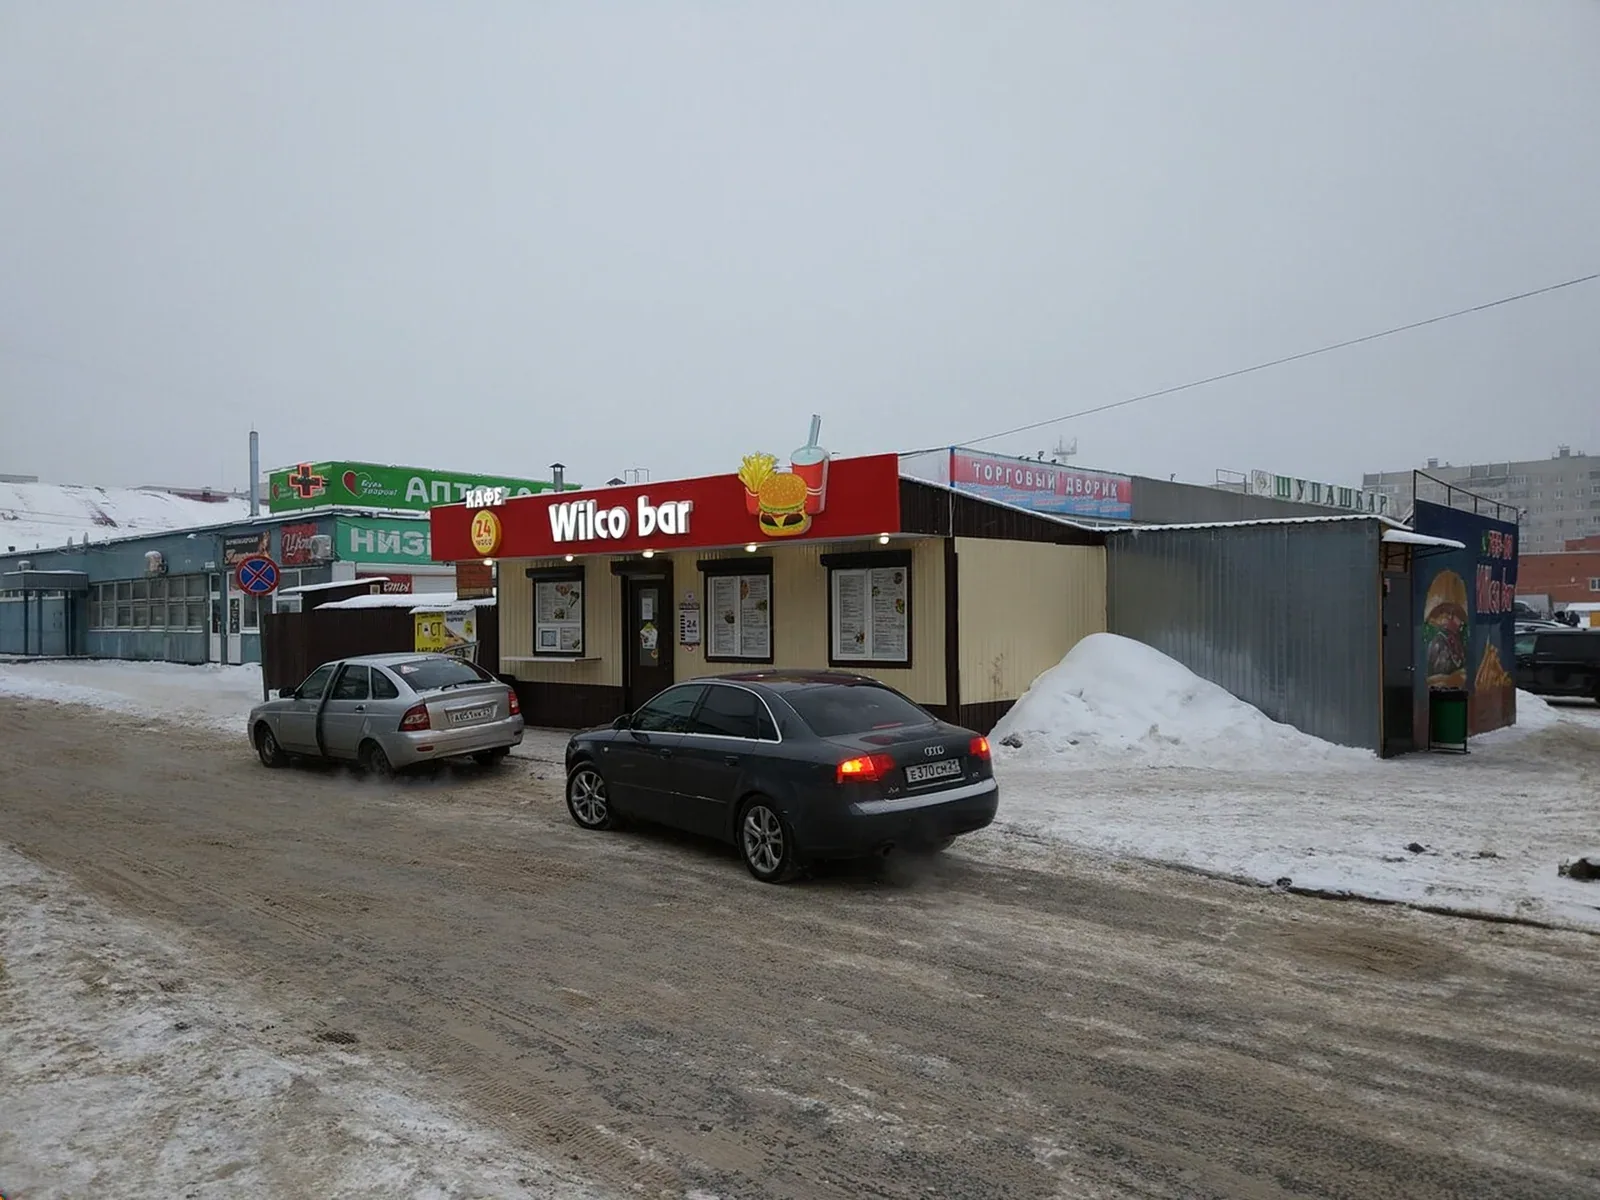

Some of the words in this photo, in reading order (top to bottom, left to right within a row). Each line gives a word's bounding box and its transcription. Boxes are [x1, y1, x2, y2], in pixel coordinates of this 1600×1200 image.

[973, 461, 1056, 490] ТОРГОВЫЙ
[1066, 476, 1118, 497] ДВОРИК
[1274, 474, 1387, 515] ШУПАШКАР
[465, 486, 504, 509] КАФЕ
[475, 520, 491, 538] 24
[548, 499, 630, 542] Wilco
[637, 495, 693, 537] bar
[350, 527, 431, 557] НИЗ
